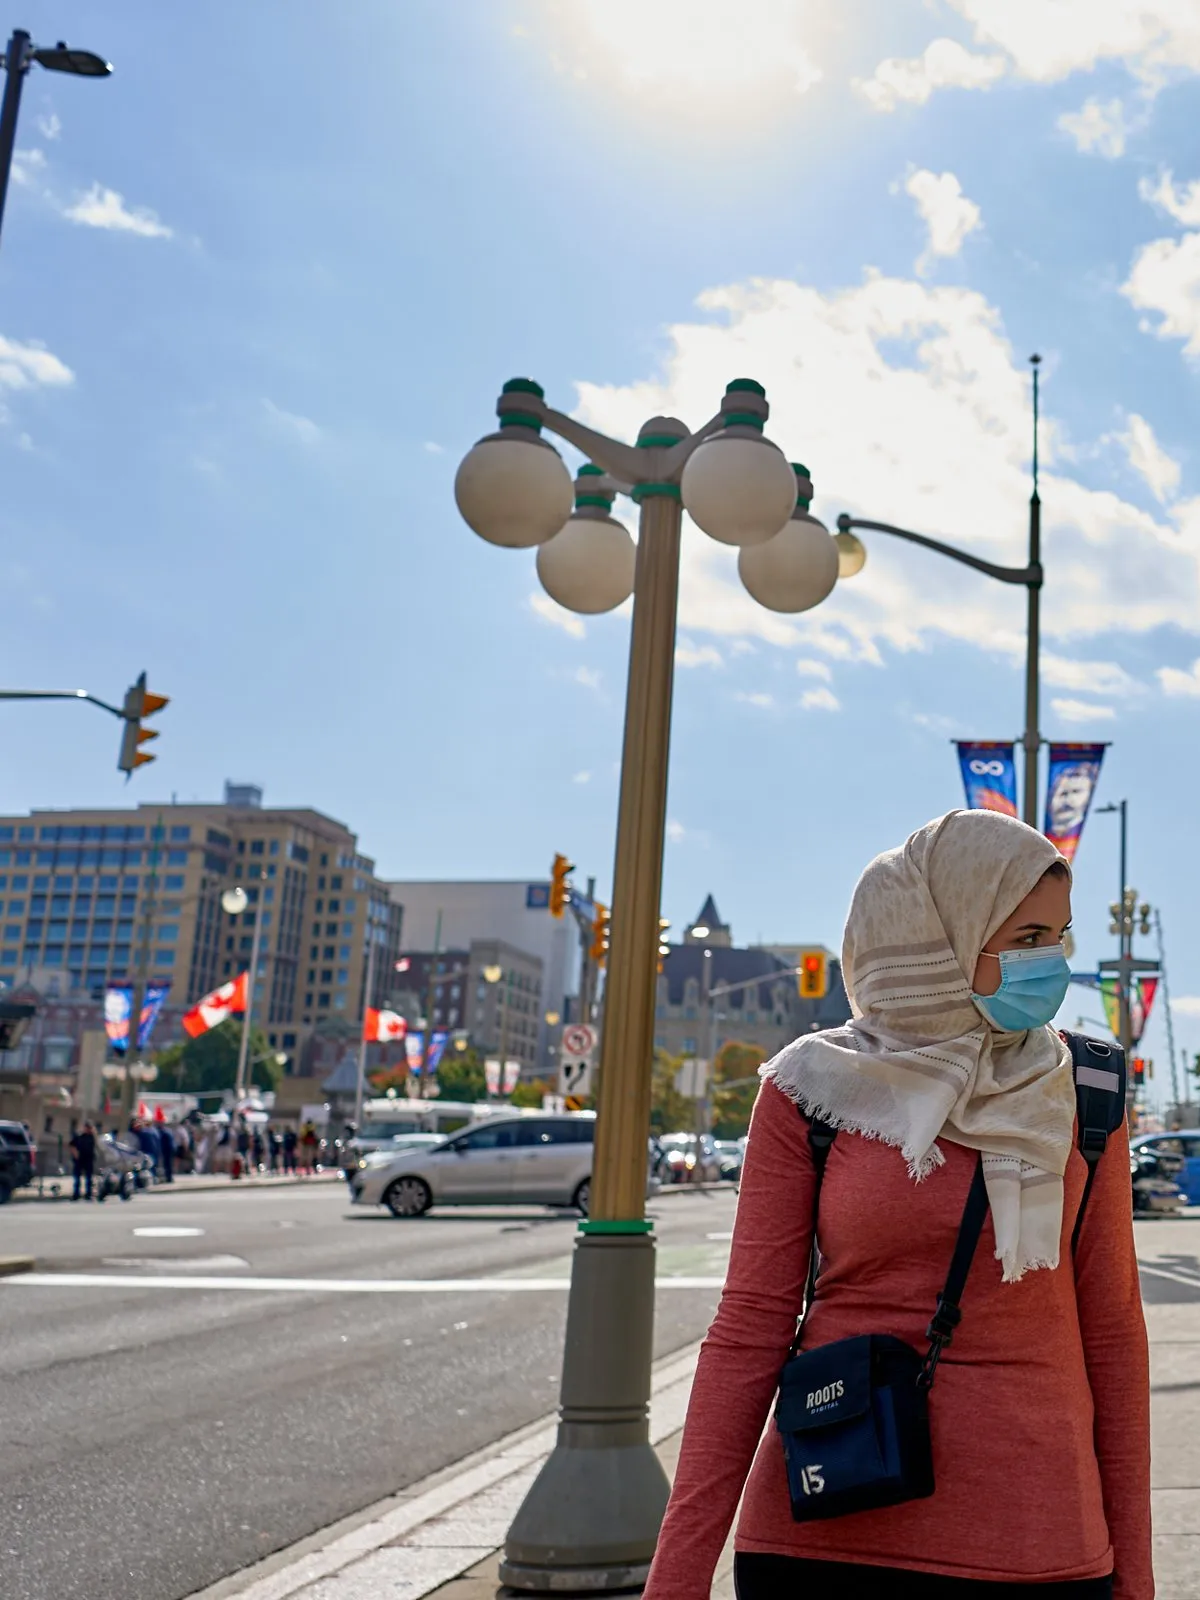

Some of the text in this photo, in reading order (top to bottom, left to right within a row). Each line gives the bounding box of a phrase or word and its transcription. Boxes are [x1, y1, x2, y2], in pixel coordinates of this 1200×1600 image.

[807, 1380, 844, 1408] ROOTS
[812, 1402, 838, 1414] DIGITAL
[802, 1465, 825, 1495] 15
